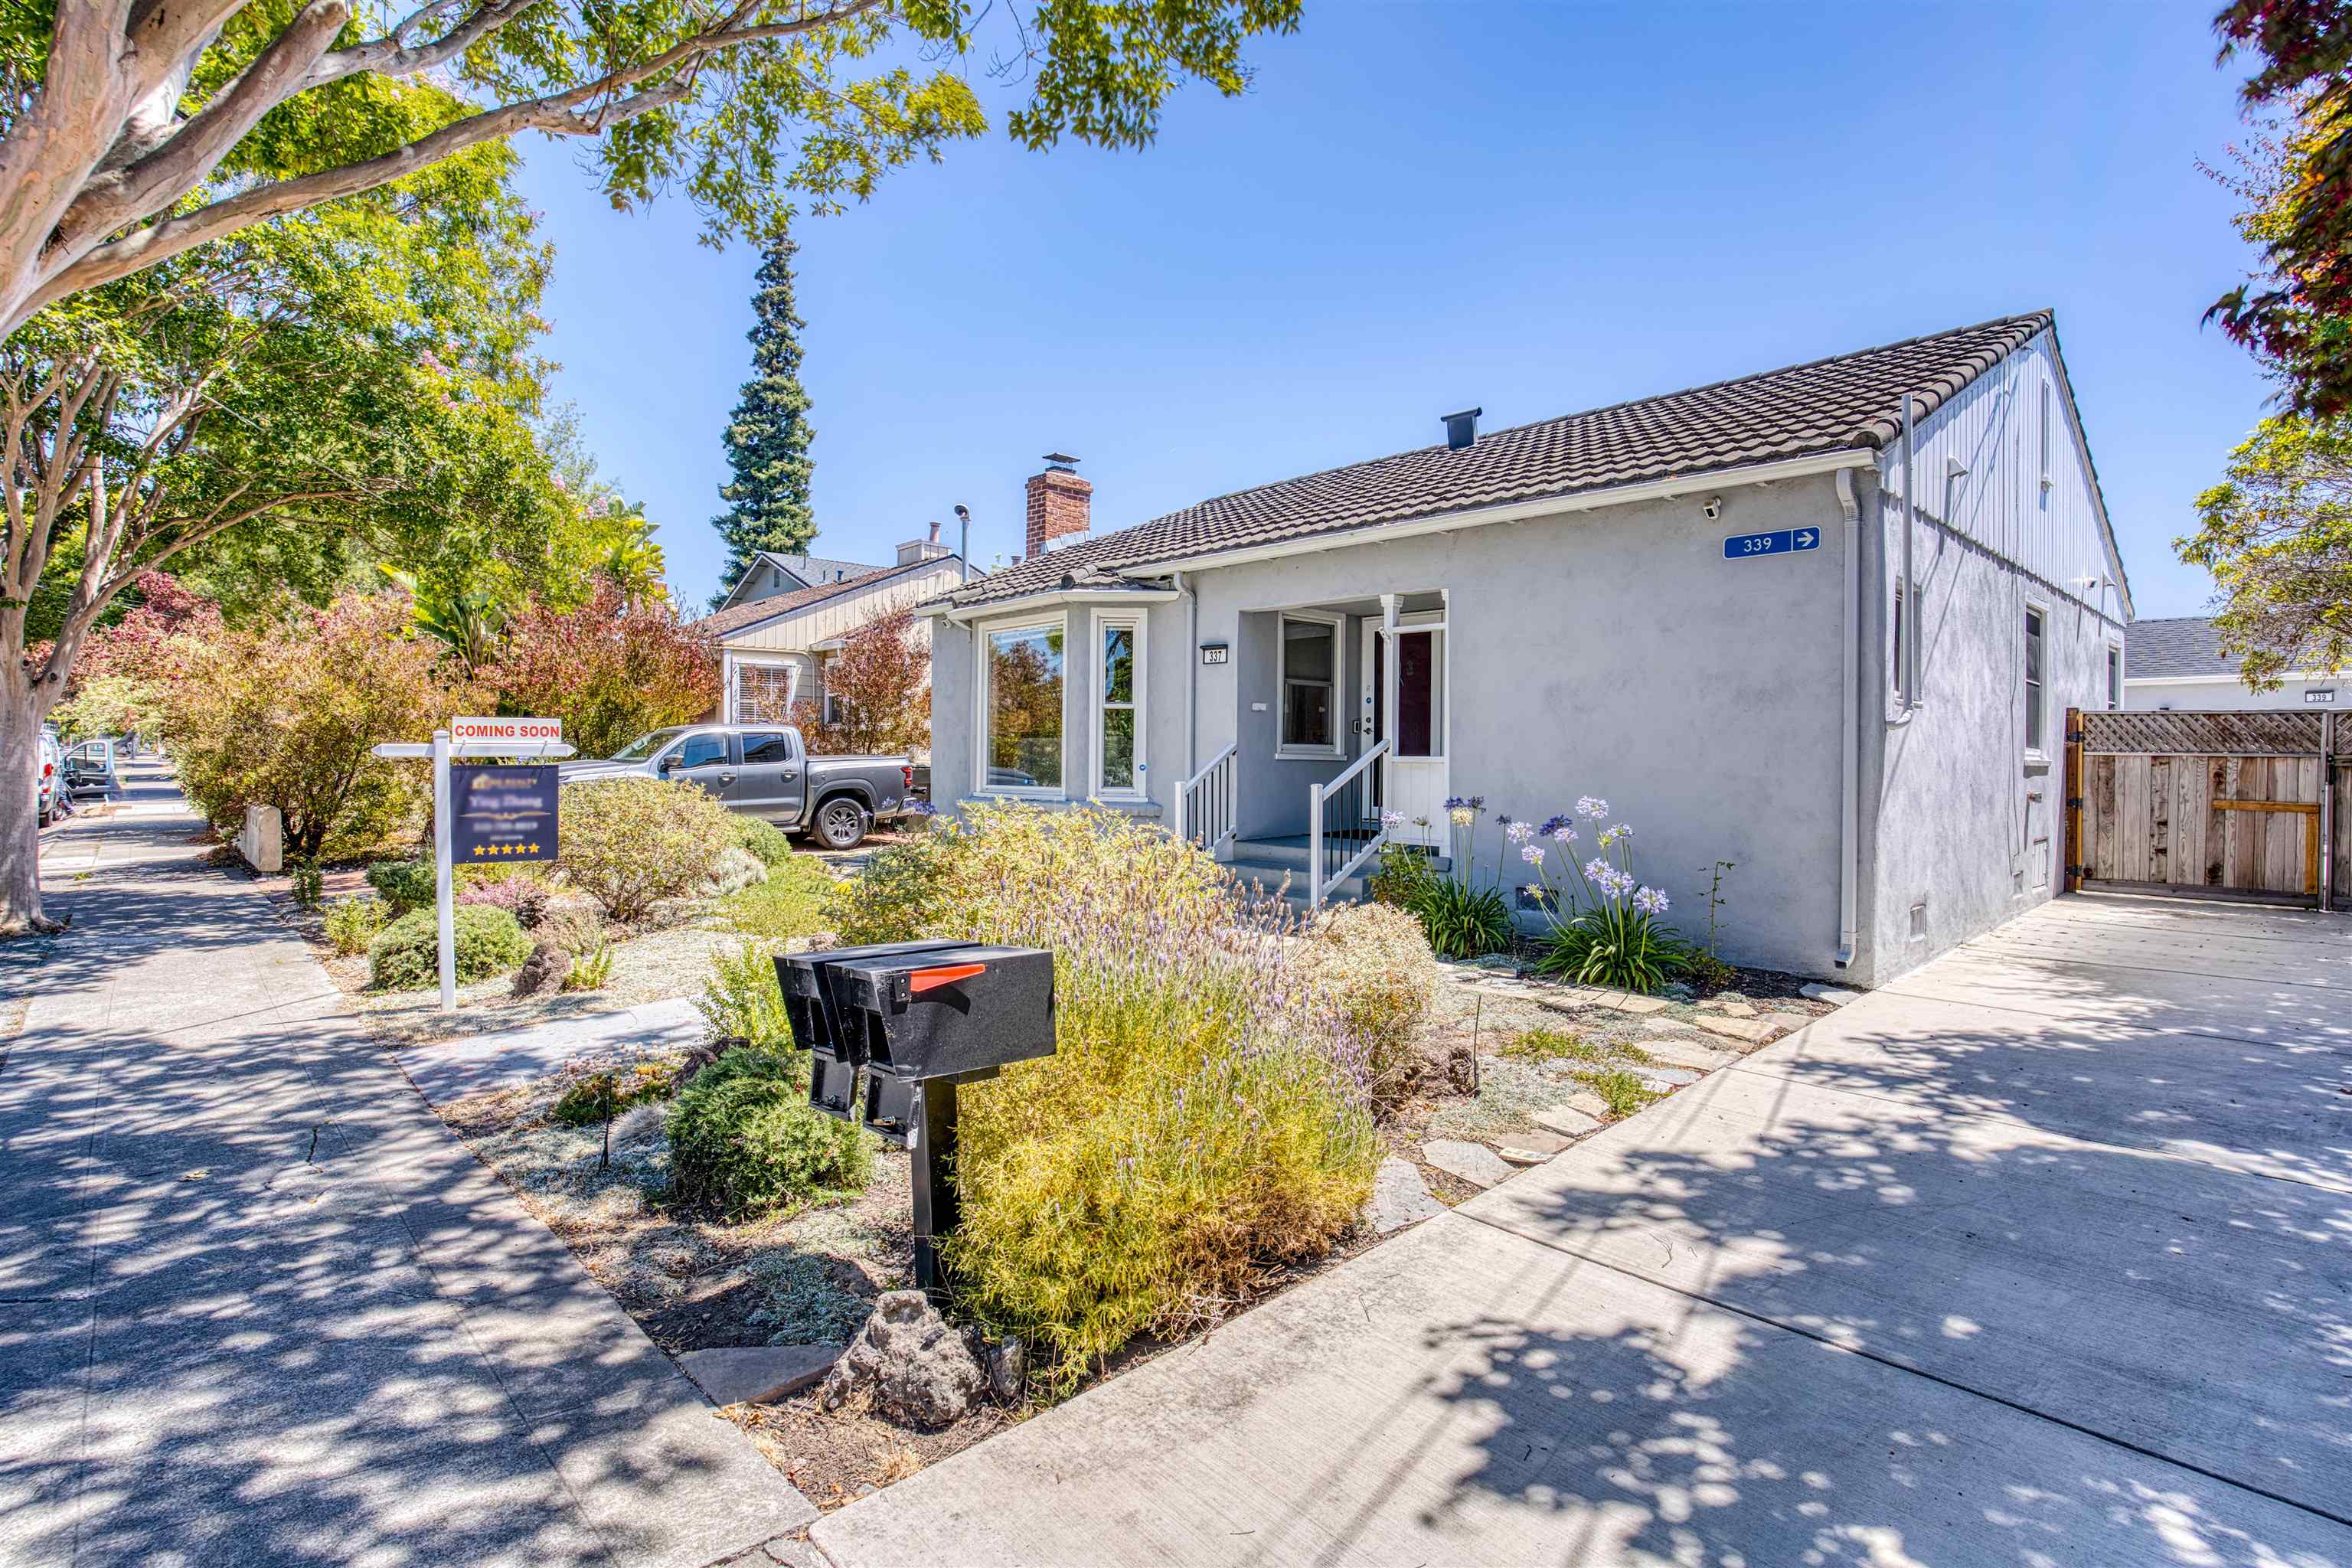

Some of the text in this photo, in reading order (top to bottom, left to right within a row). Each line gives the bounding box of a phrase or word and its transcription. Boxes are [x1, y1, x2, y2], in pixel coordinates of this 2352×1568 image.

[1743, 537, 1772, 553] 339
[1209, 650, 1223, 662] 337
[455, 724, 560, 738] COMING SOON
